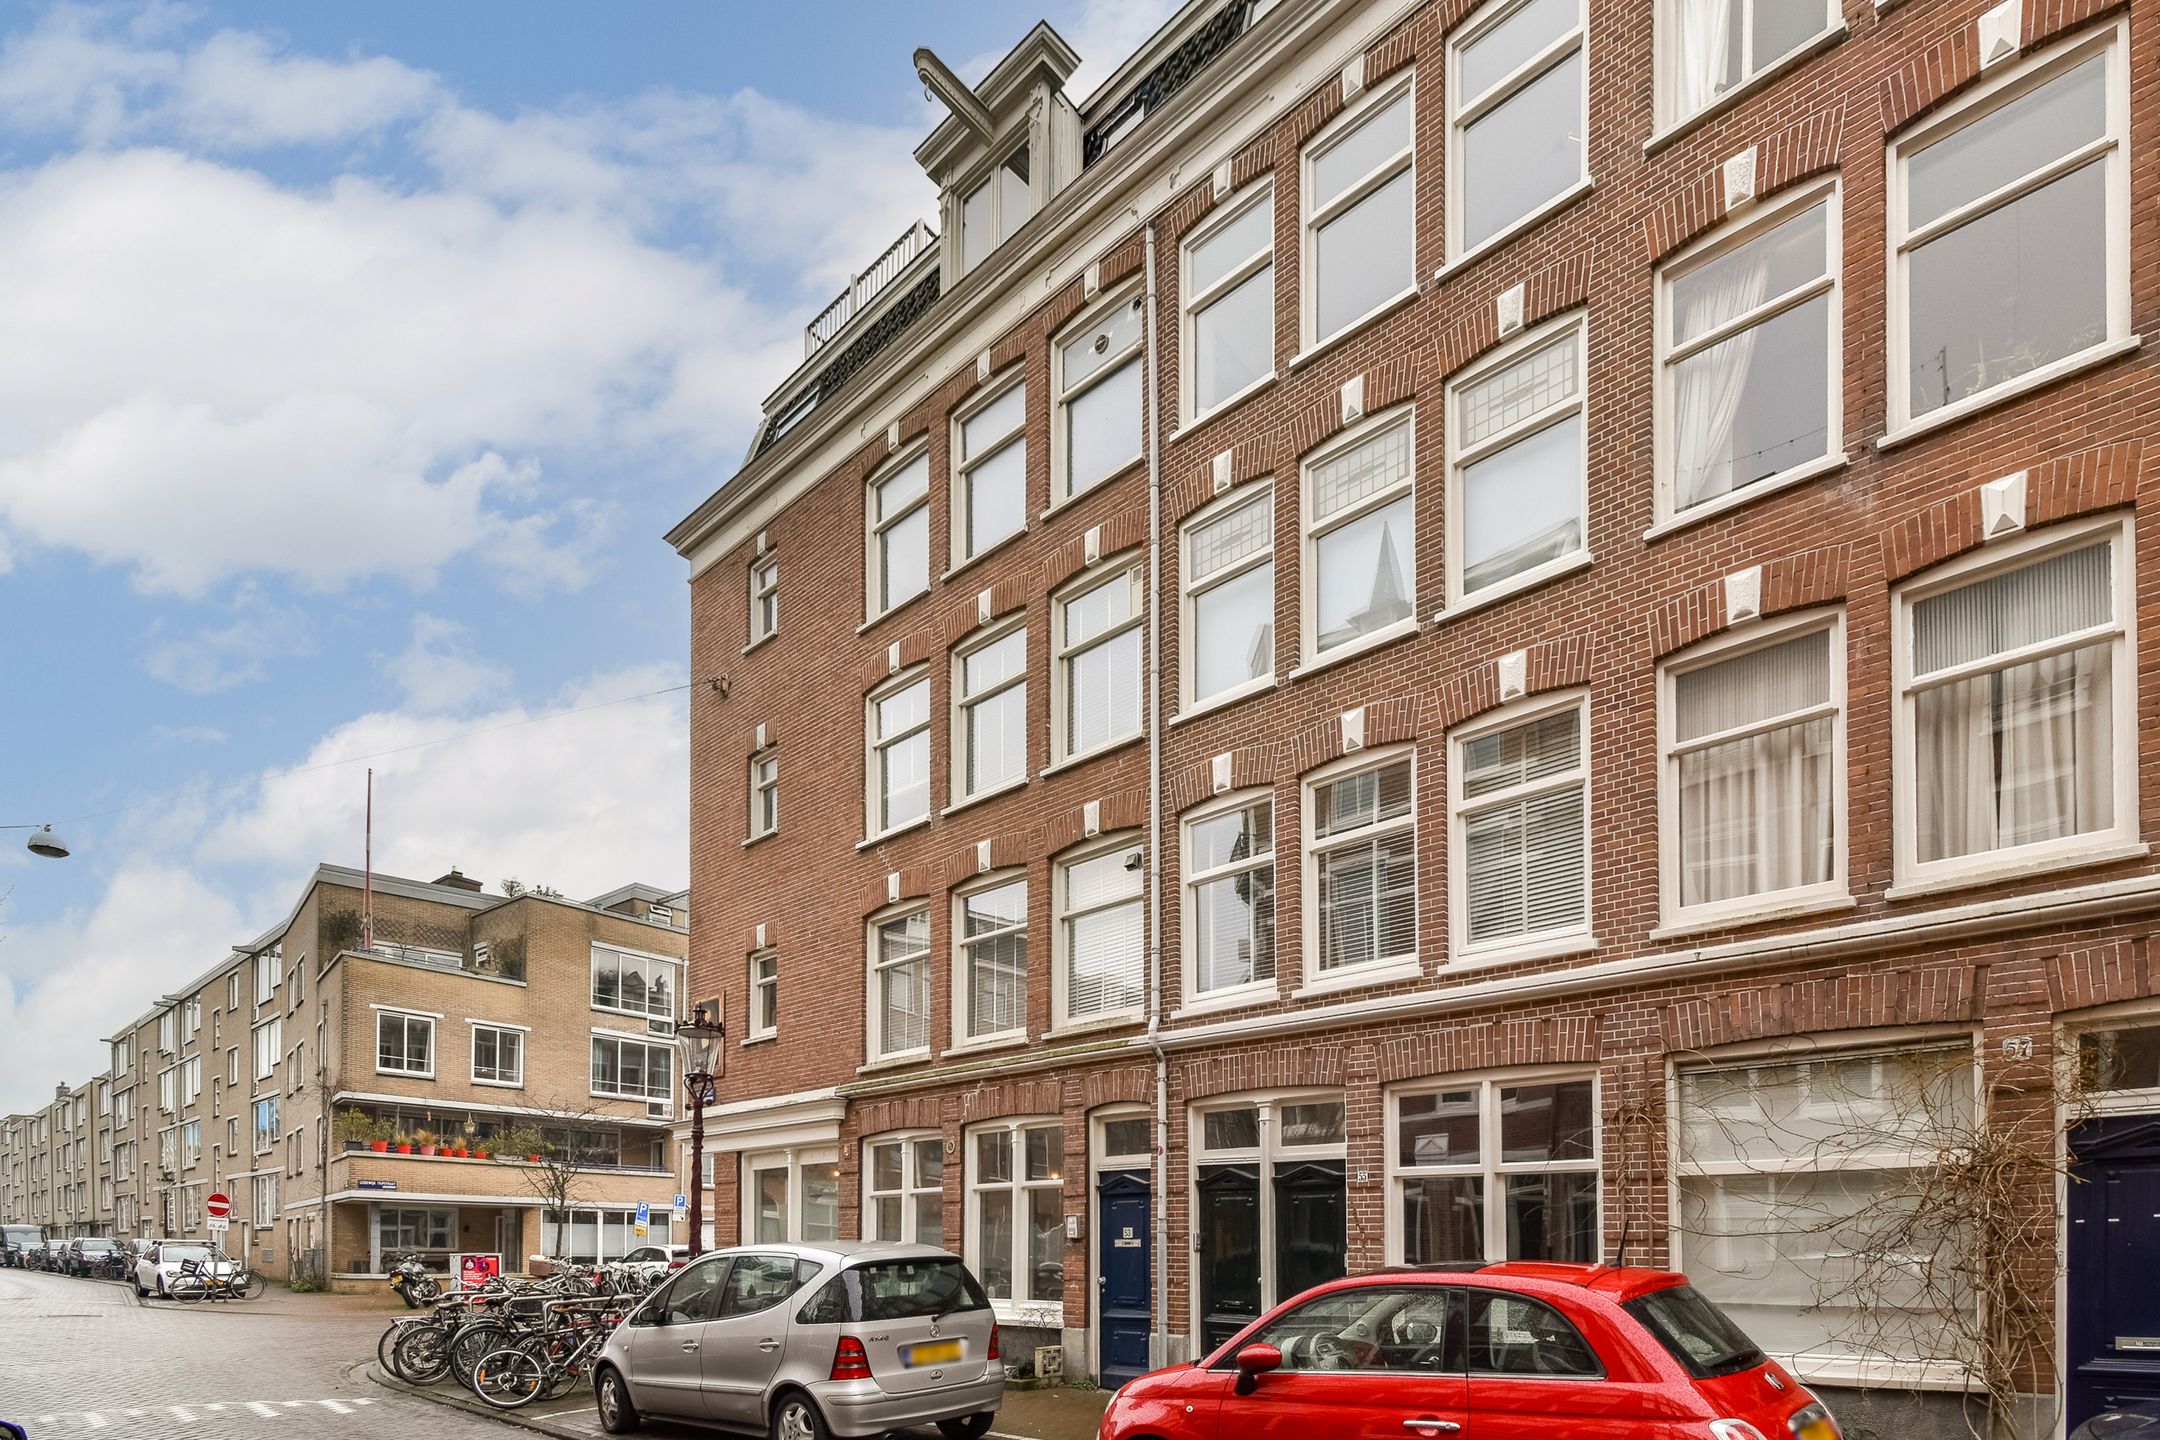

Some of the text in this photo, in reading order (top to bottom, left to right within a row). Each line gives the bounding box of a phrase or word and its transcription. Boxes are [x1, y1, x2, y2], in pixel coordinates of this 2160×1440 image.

[2004, 1038, 2031, 1059] 57
[1358, 1171, 1367, 1181] 55
[677, 1197, 684, 1206] P
[640, 1203, 648, 1214] P
[1124, 1228, 1132, 1238] 53
